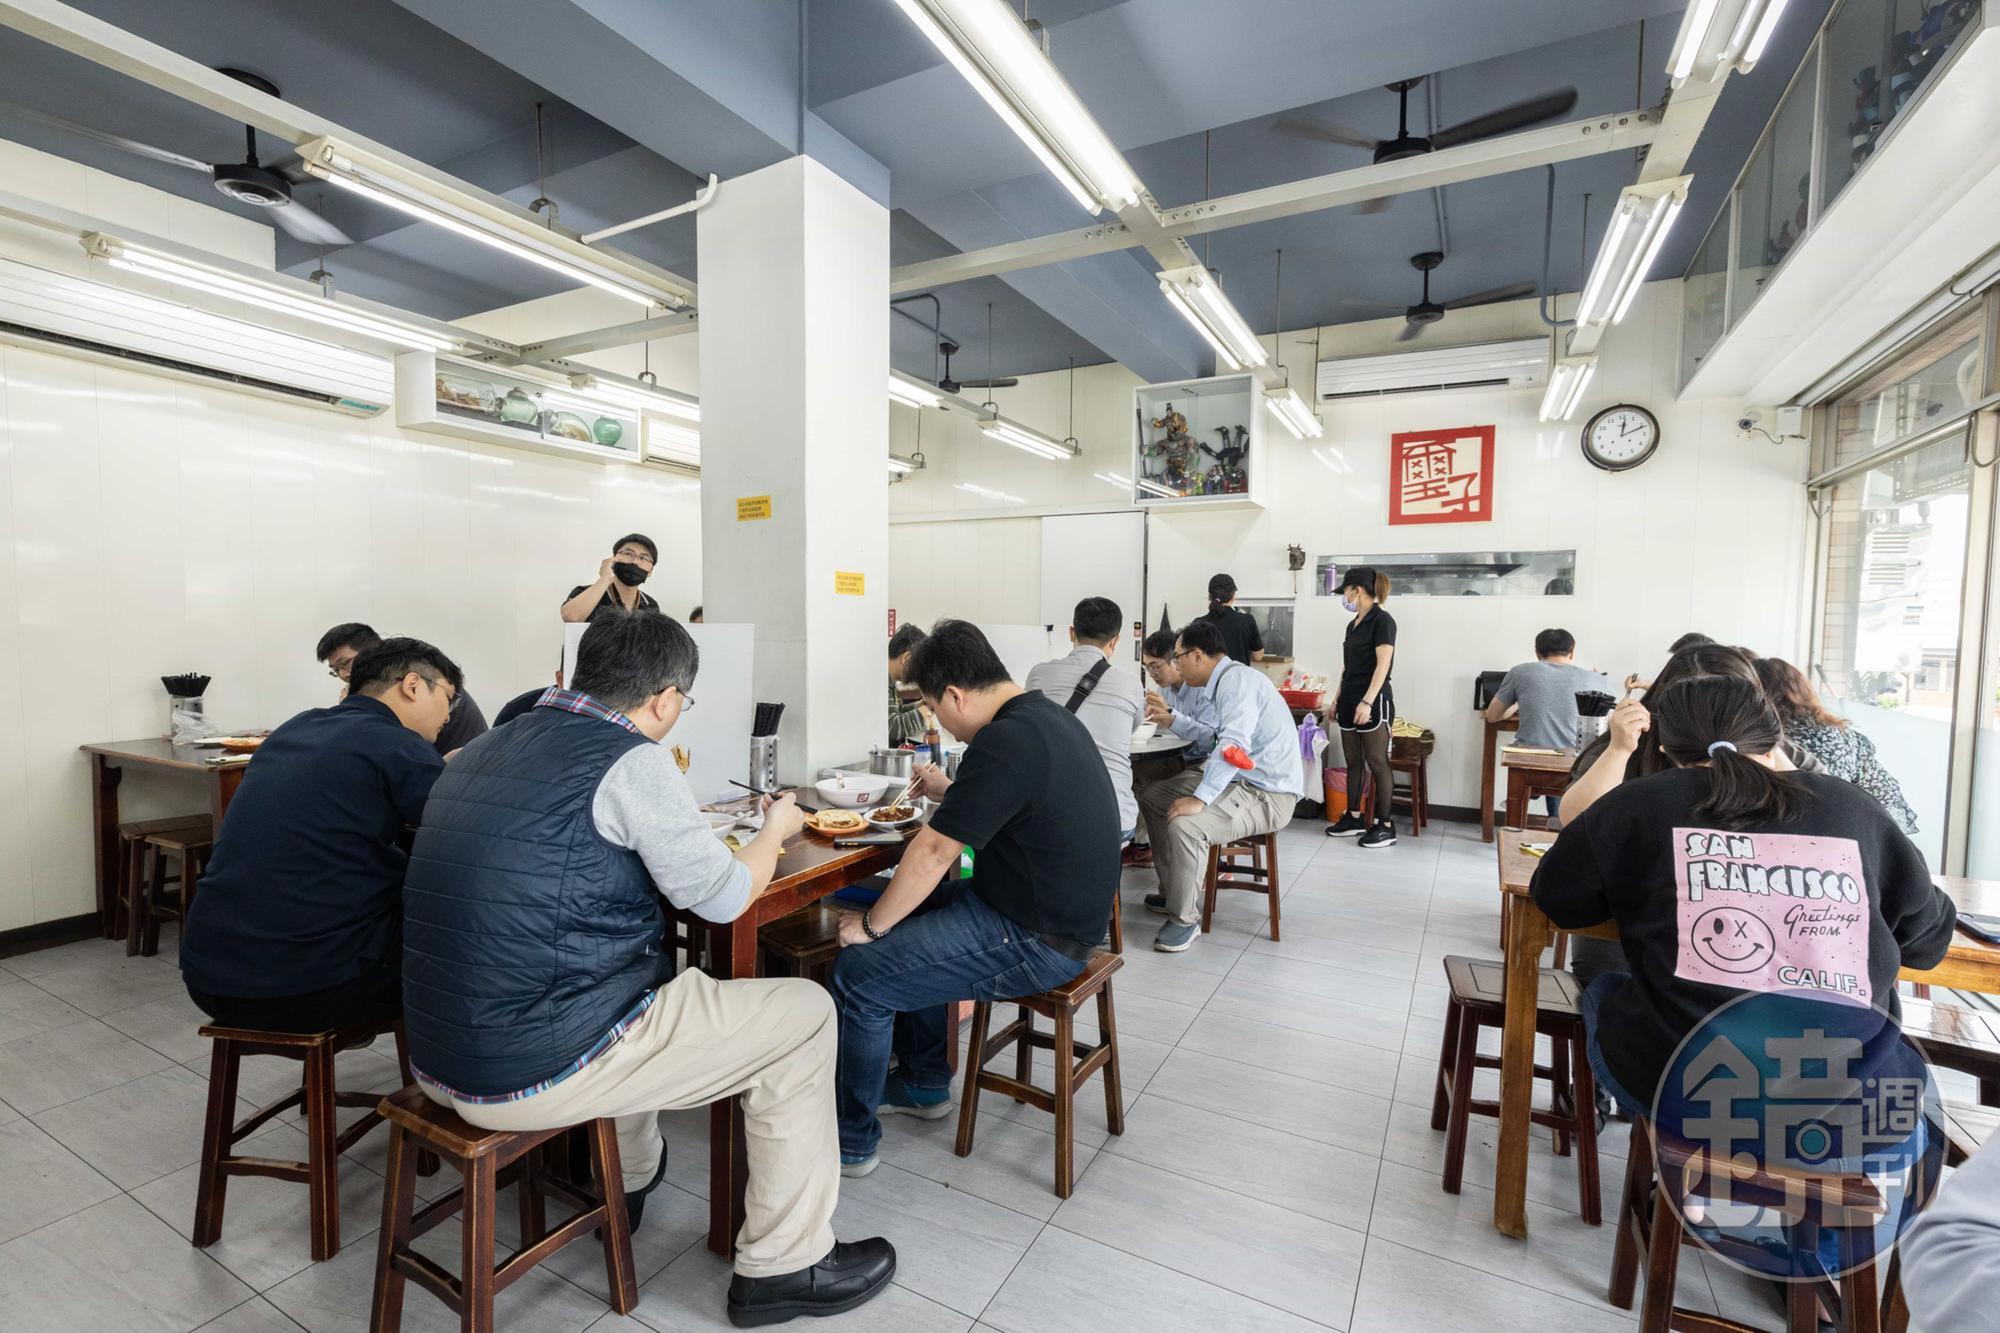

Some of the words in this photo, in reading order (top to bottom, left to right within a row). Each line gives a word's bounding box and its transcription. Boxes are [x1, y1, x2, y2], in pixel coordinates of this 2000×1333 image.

[1686, 832, 1754, 859] SAN
[1687, 860, 1860, 904] FRANCISCO
[1777, 966, 1867, 996] CALIF.
